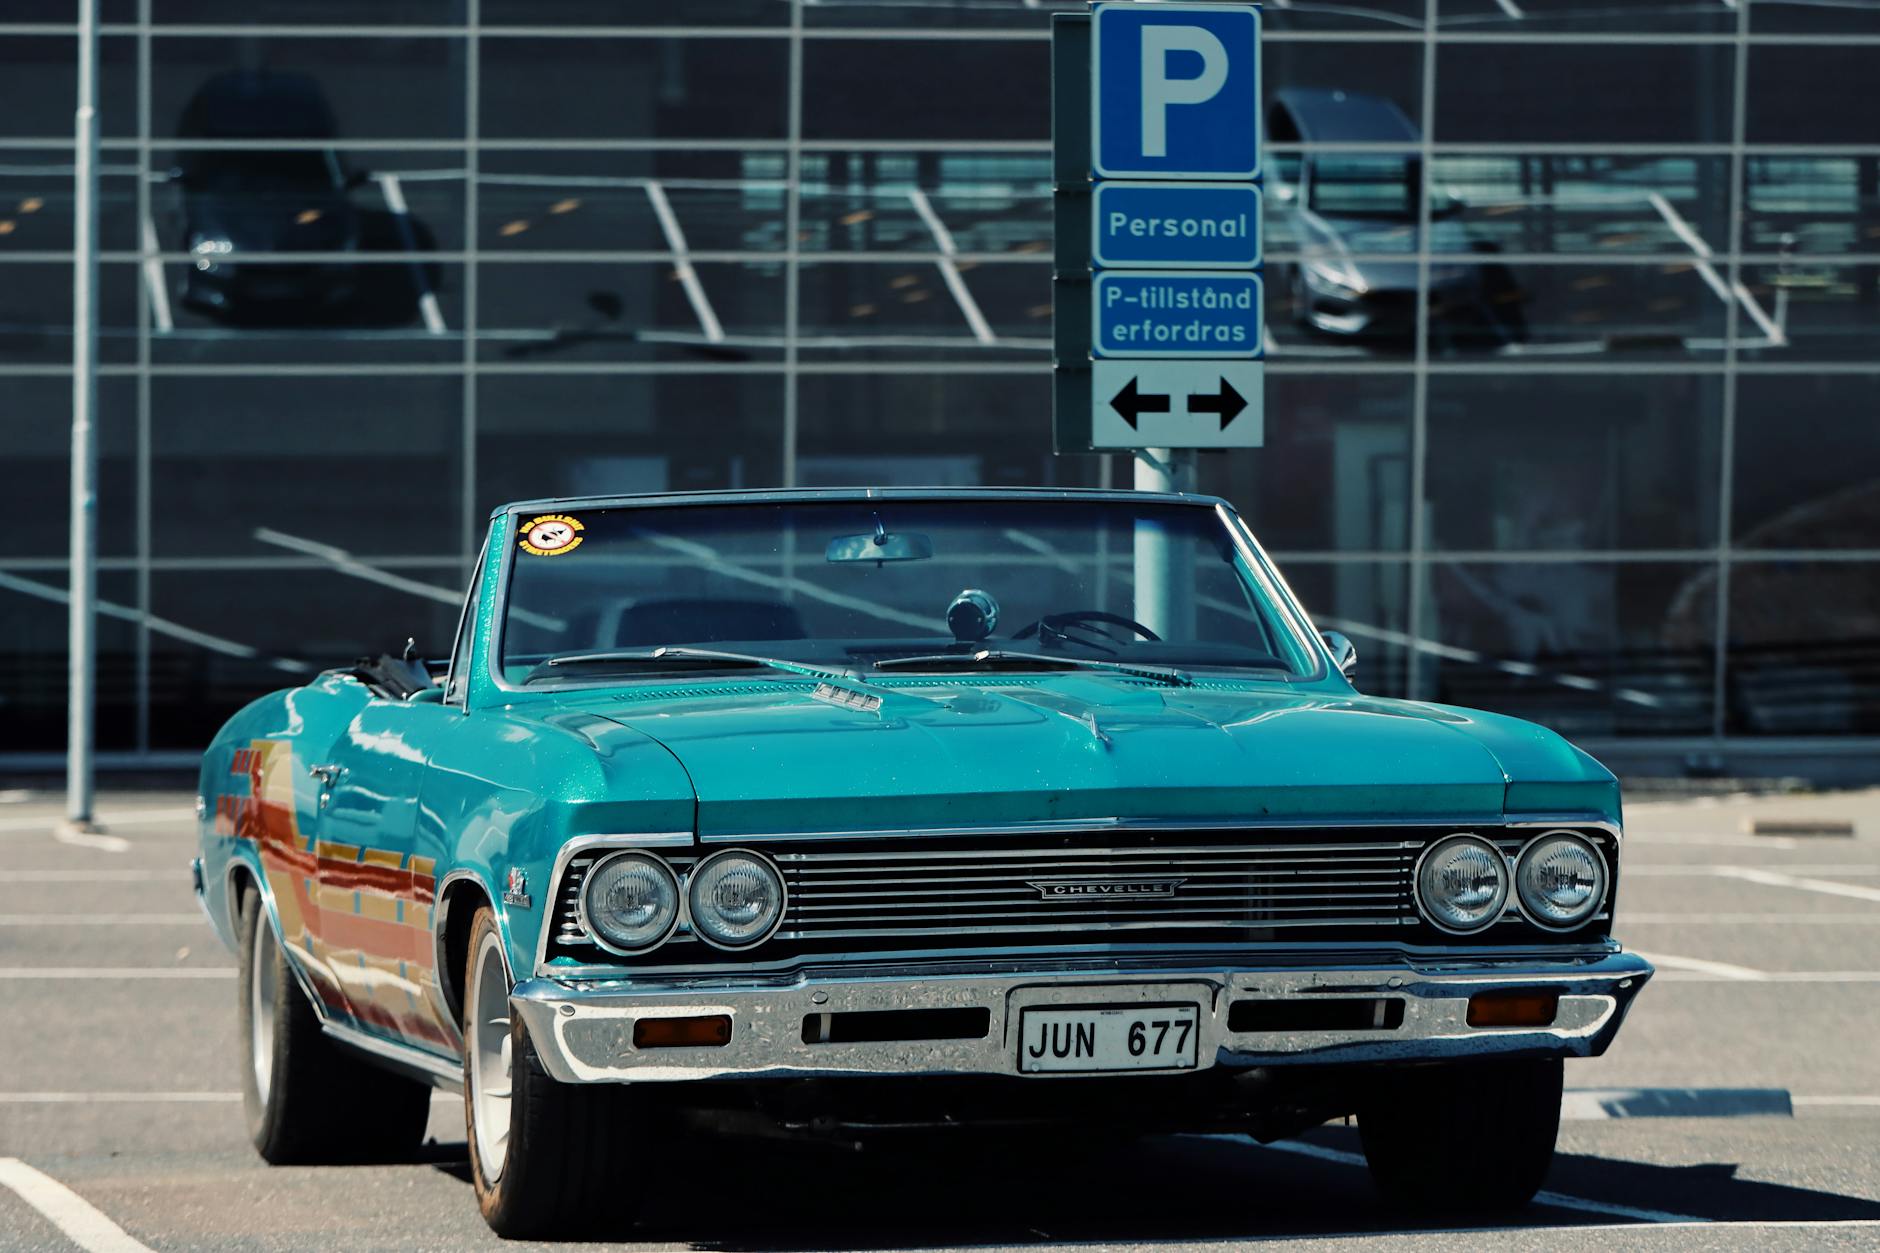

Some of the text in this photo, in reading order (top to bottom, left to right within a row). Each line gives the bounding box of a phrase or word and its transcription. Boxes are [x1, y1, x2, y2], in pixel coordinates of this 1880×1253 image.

[1141, 25, 1229, 157] P
[1109, 212, 1247, 238] Personal
[1107, 286, 1251, 310] P-tillstånd
[1112, 319, 1246, 342] erfordras
[1053, 884, 1163, 894] CHEVELLE
[1029, 1020, 1193, 1058] JUN 677
